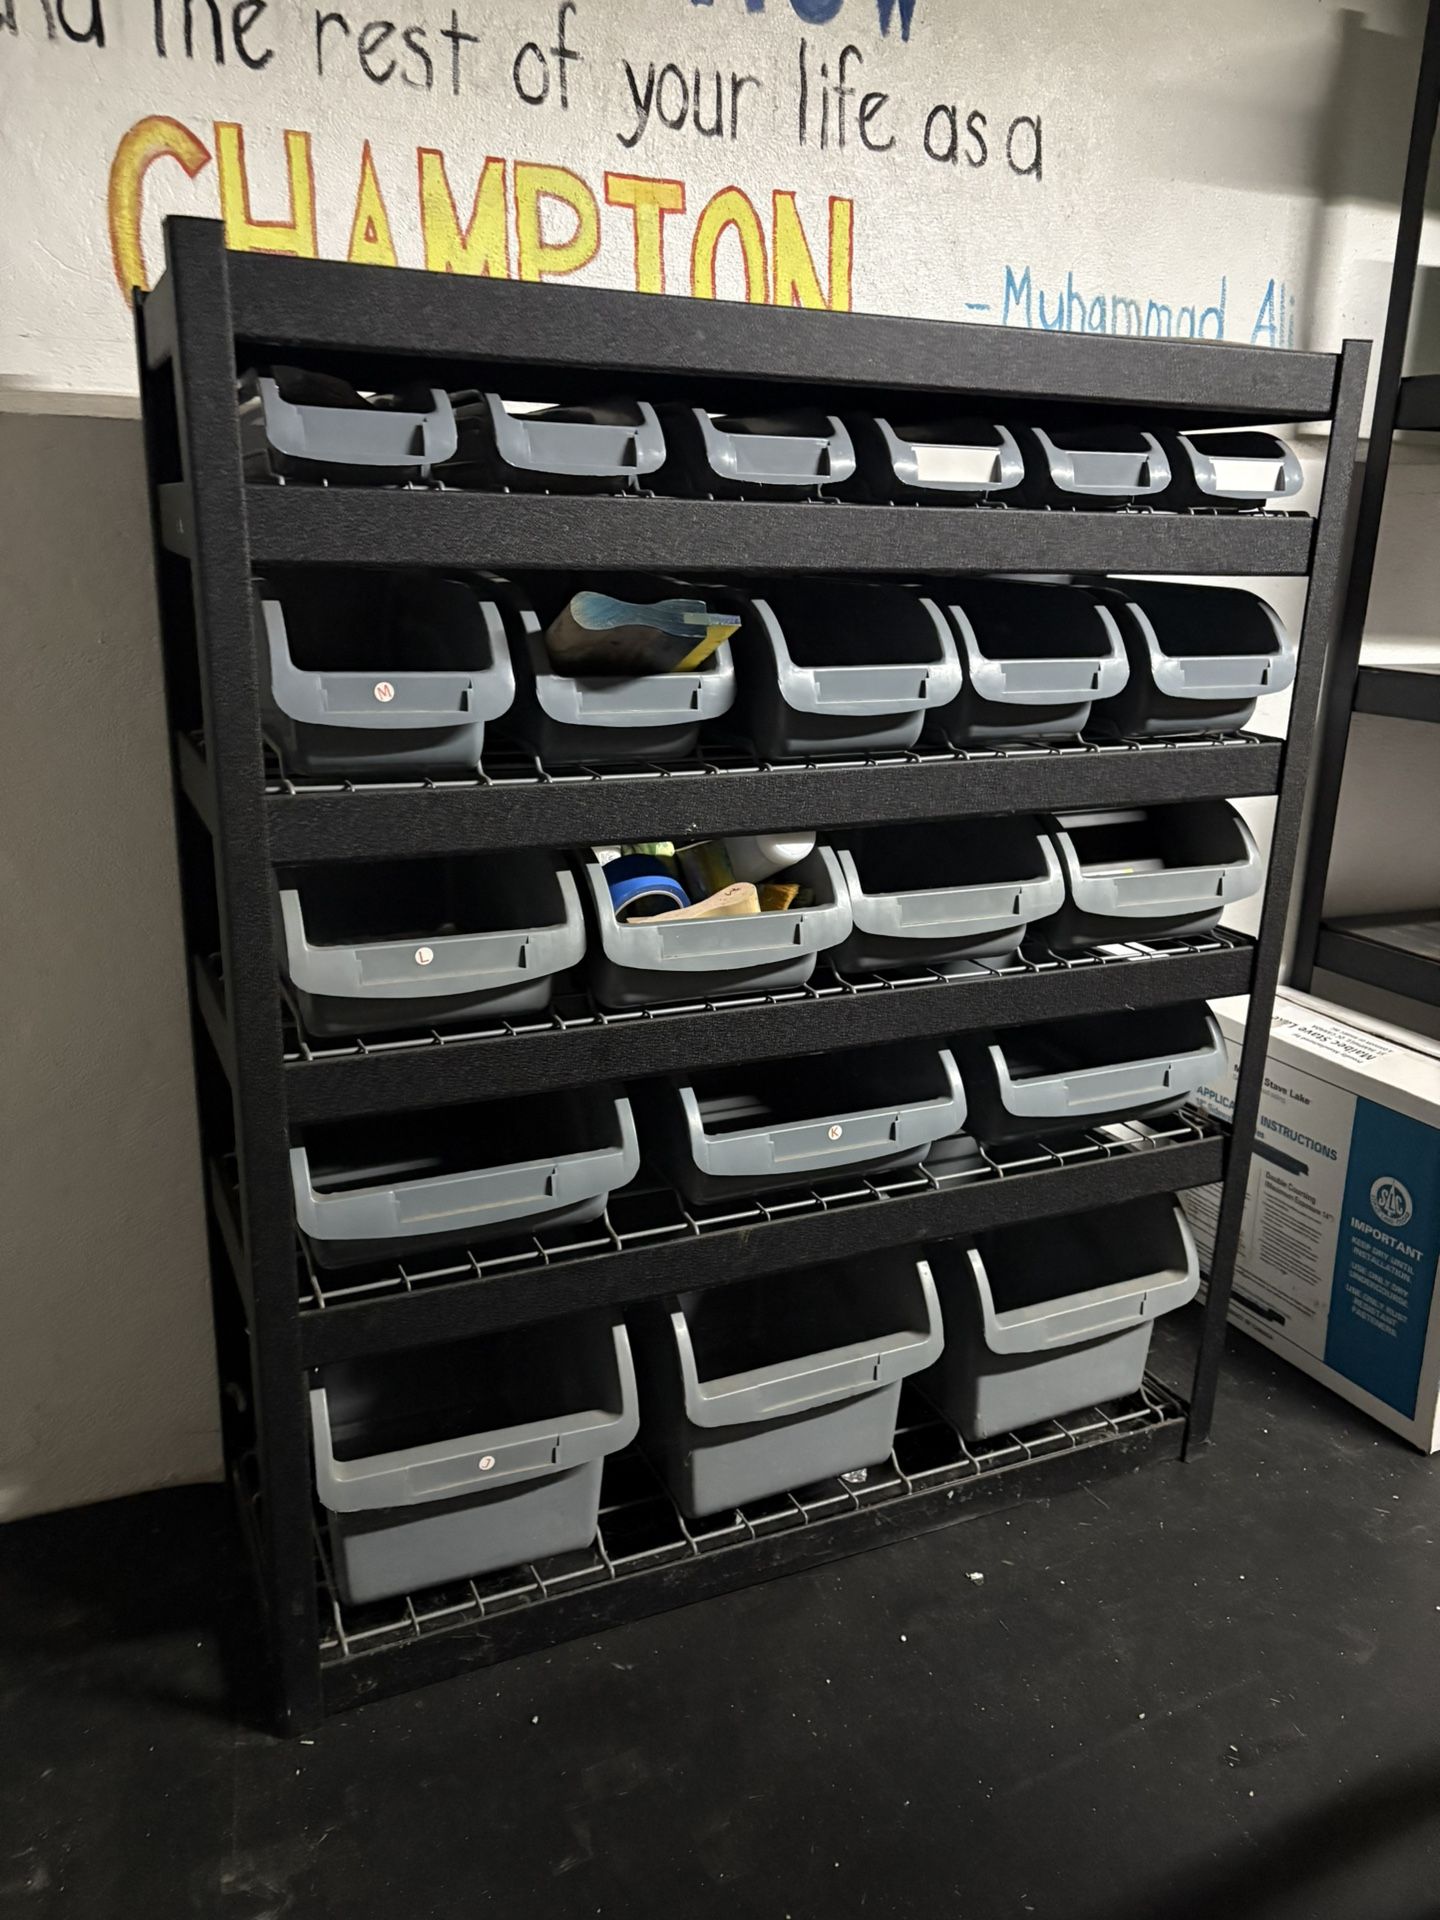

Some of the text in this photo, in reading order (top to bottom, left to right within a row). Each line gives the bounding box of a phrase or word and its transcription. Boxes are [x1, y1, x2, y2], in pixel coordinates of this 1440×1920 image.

[315, 8, 478, 95] rest
[513, 1, 583, 110] of
[616, 59, 761, 148] your
[799, 37, 896, 151] life
[924, 104, 987, 168] as
[1006, 115, 1042, 182] a
[1250, 278, 1294, 350] Ali
[1297, 1026, 1332, 1042] Stave
[1263, 1077, 1288, 1095] Stave
[1289, 1088, 1311, 1105] Lake
[1259, 1114, 1339, 1161] INSTRUCTIONS
[1350, 1216, 1424, 1262] IMPORTANT
